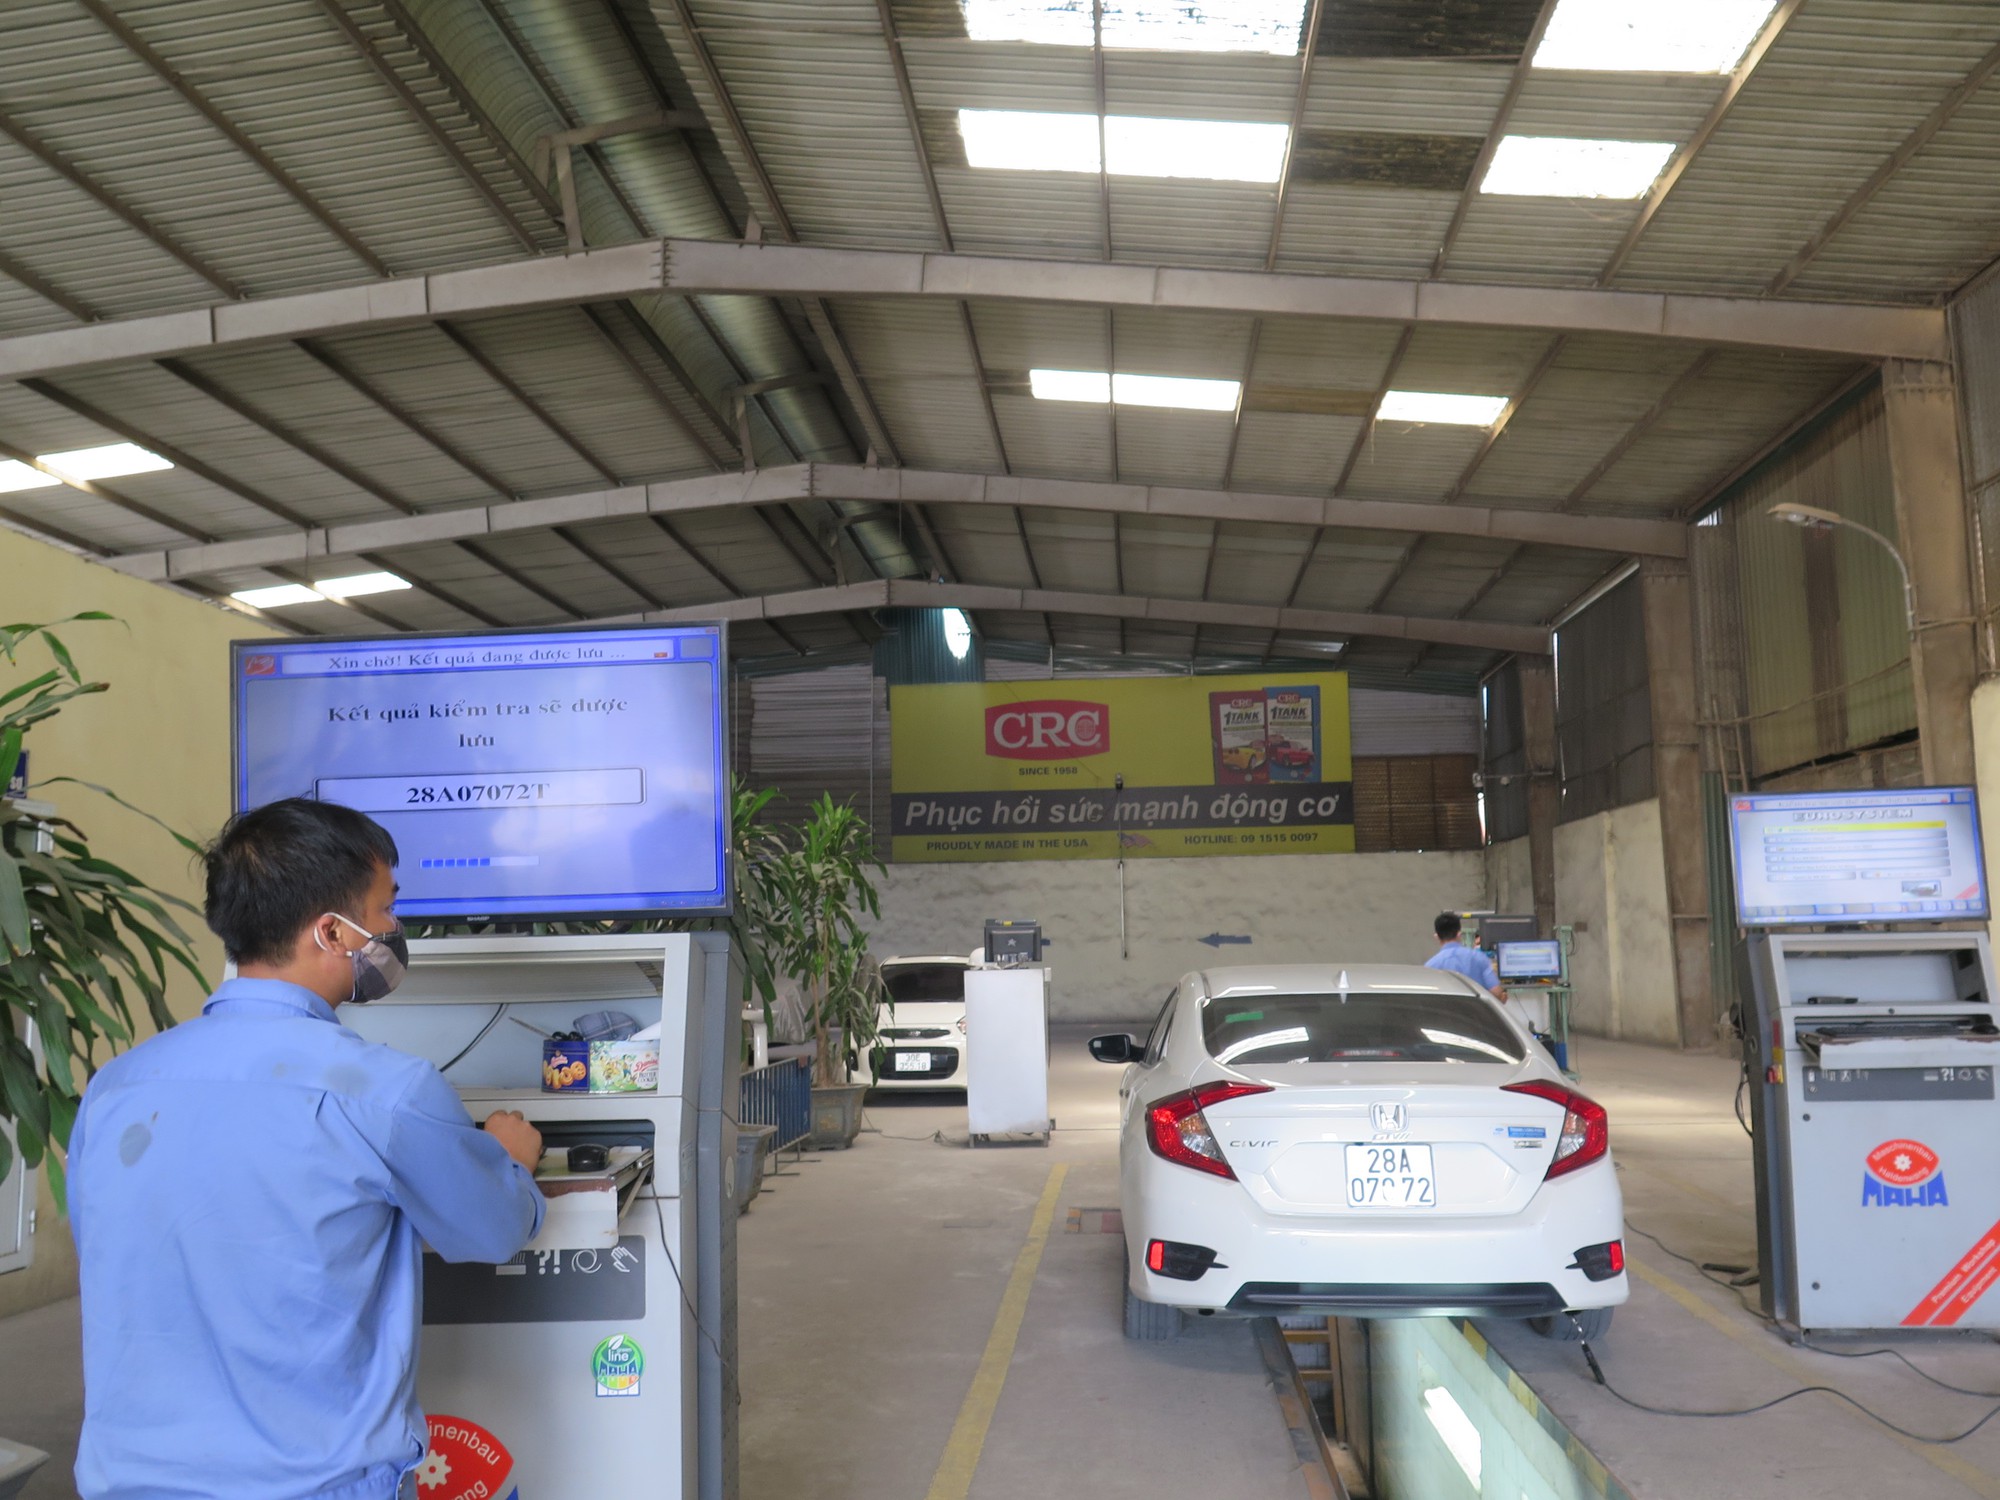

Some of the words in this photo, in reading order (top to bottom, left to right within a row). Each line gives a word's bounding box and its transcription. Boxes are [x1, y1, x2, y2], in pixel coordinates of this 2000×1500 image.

[329, 657, 359, 669] Xin
[409, 653, 439, 666] Kết
[445, 651, 475, 665] quả
[577, 647, 603, 659] lưu
[328, 704, 370, 721] Kết
[380, 703, 419, 723] quả
[429, 699, 487, 718] kiểm
[497, 702, 530, 715] tra
[539, 700, 561, 713] sẽ
[1231, 711, 1259, 721] TANK
[1278, 707, 1306, 718] TANK
[994, 710, 1101, 749] CRC
[459, 733, 495, 748] lưu
[1019, 767, 1049, 776] SINCE
[1054, 766, 1078, 775] 1958
[406, 783, 551, 804] 28A07072T
[905, 800, 983, 832] Phục
[991, 795, 1041, 825] hồi
[1049, 797, 1104, 823] sức
[1113, 794, 1199, 827] mạnh
[1209, 792, 1288, 824] động
[1298, 794, 1340, 817] cơ
[926, 842, 981, 850] PROUDLY
[985, 841, 1019, 849] MADE
[1039, 840, 1060, 848] THE
[1063, 839, 1089, 847] USA
[1184, 835, 1237, 844] HOTLINE:
[1241, 834, 1255, 843] 09
[1260, 833, 1286, 842] 1515
[1290, 833, 1319, 842] 0097
[1366, 1148, 1412, 1173] 28A
[1861, 1169, 1949, 1207] MAHA
[608, 1349, 629, 1362] line
